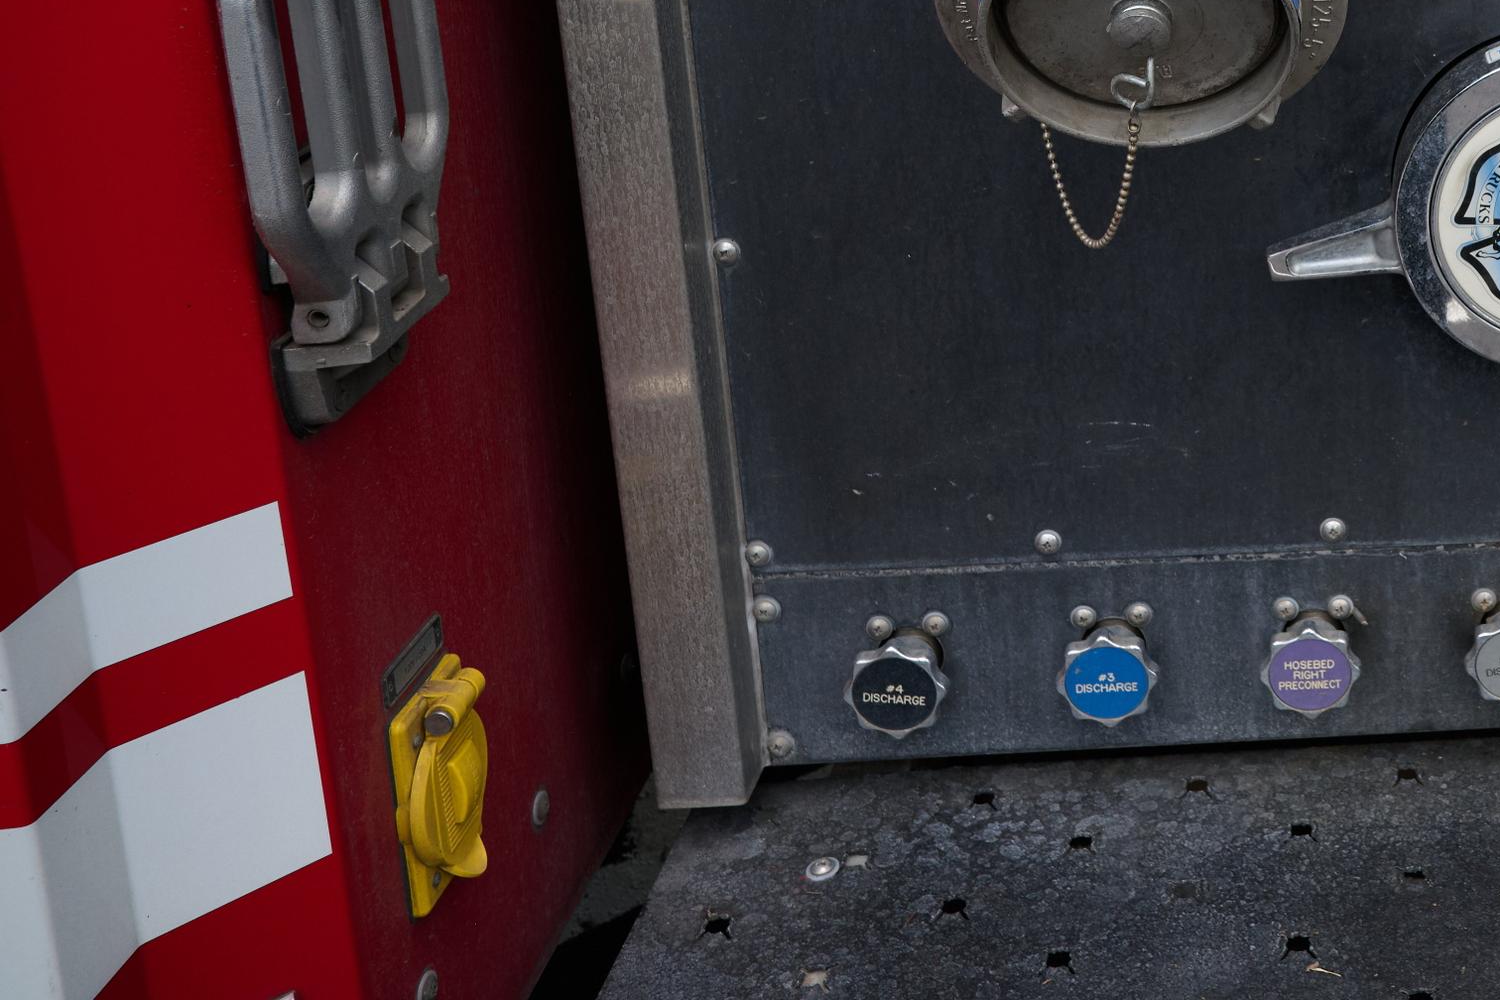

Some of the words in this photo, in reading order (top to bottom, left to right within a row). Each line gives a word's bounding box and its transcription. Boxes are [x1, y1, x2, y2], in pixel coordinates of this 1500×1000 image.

[1284, 659, 1335, 670] HOSEBED
[1098, 672, 1115, 682] #3
[1293, 669, 1326, 680] RIGHT
[886, 684, 904, 694] #4
[1075, 681, 1138, 694] DISCHARGE
[1278, 679, 1342, 690] PRECONNECT
[862, 692, 926, 706] DISCHARGE
